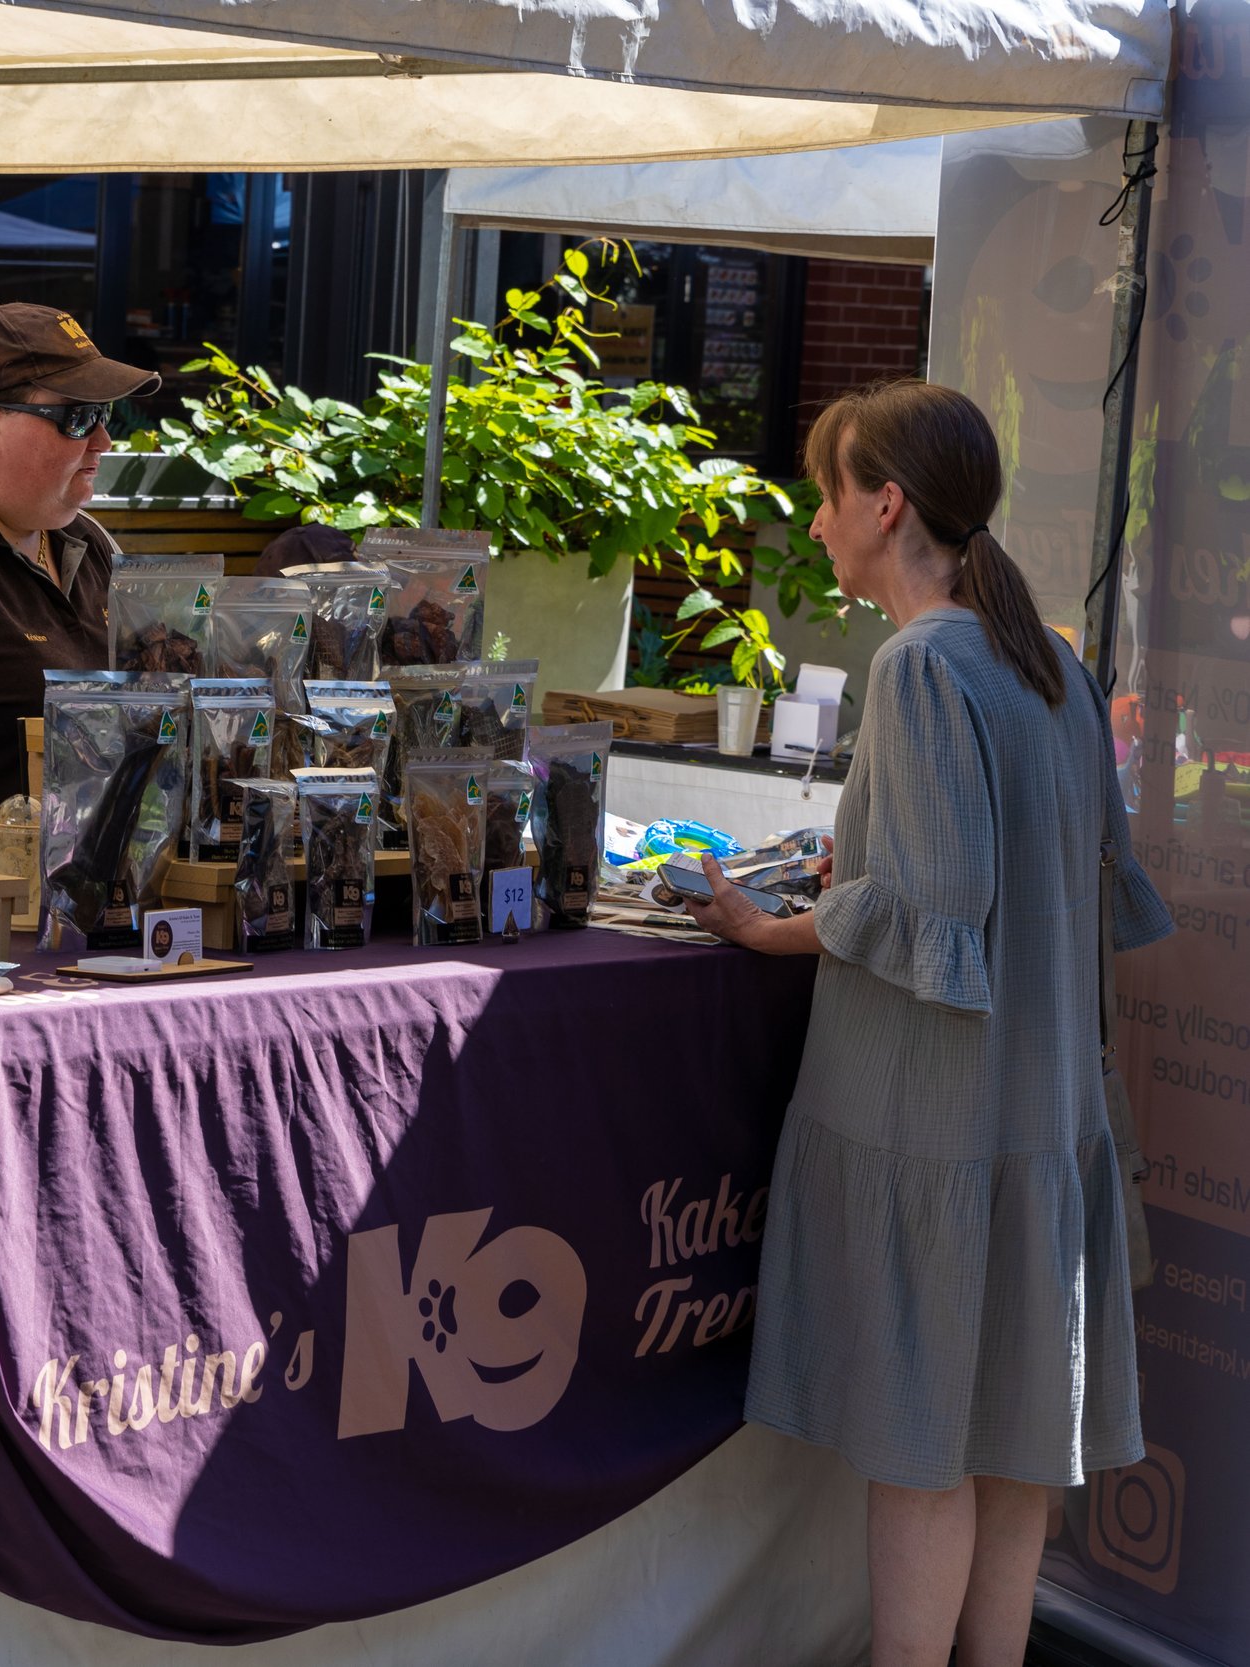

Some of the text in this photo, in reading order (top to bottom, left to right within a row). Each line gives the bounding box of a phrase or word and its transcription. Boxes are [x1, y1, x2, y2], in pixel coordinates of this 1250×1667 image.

[504, 888, 524, 904] $12
[33, 1207, 588, 1451] Kristine's K9
